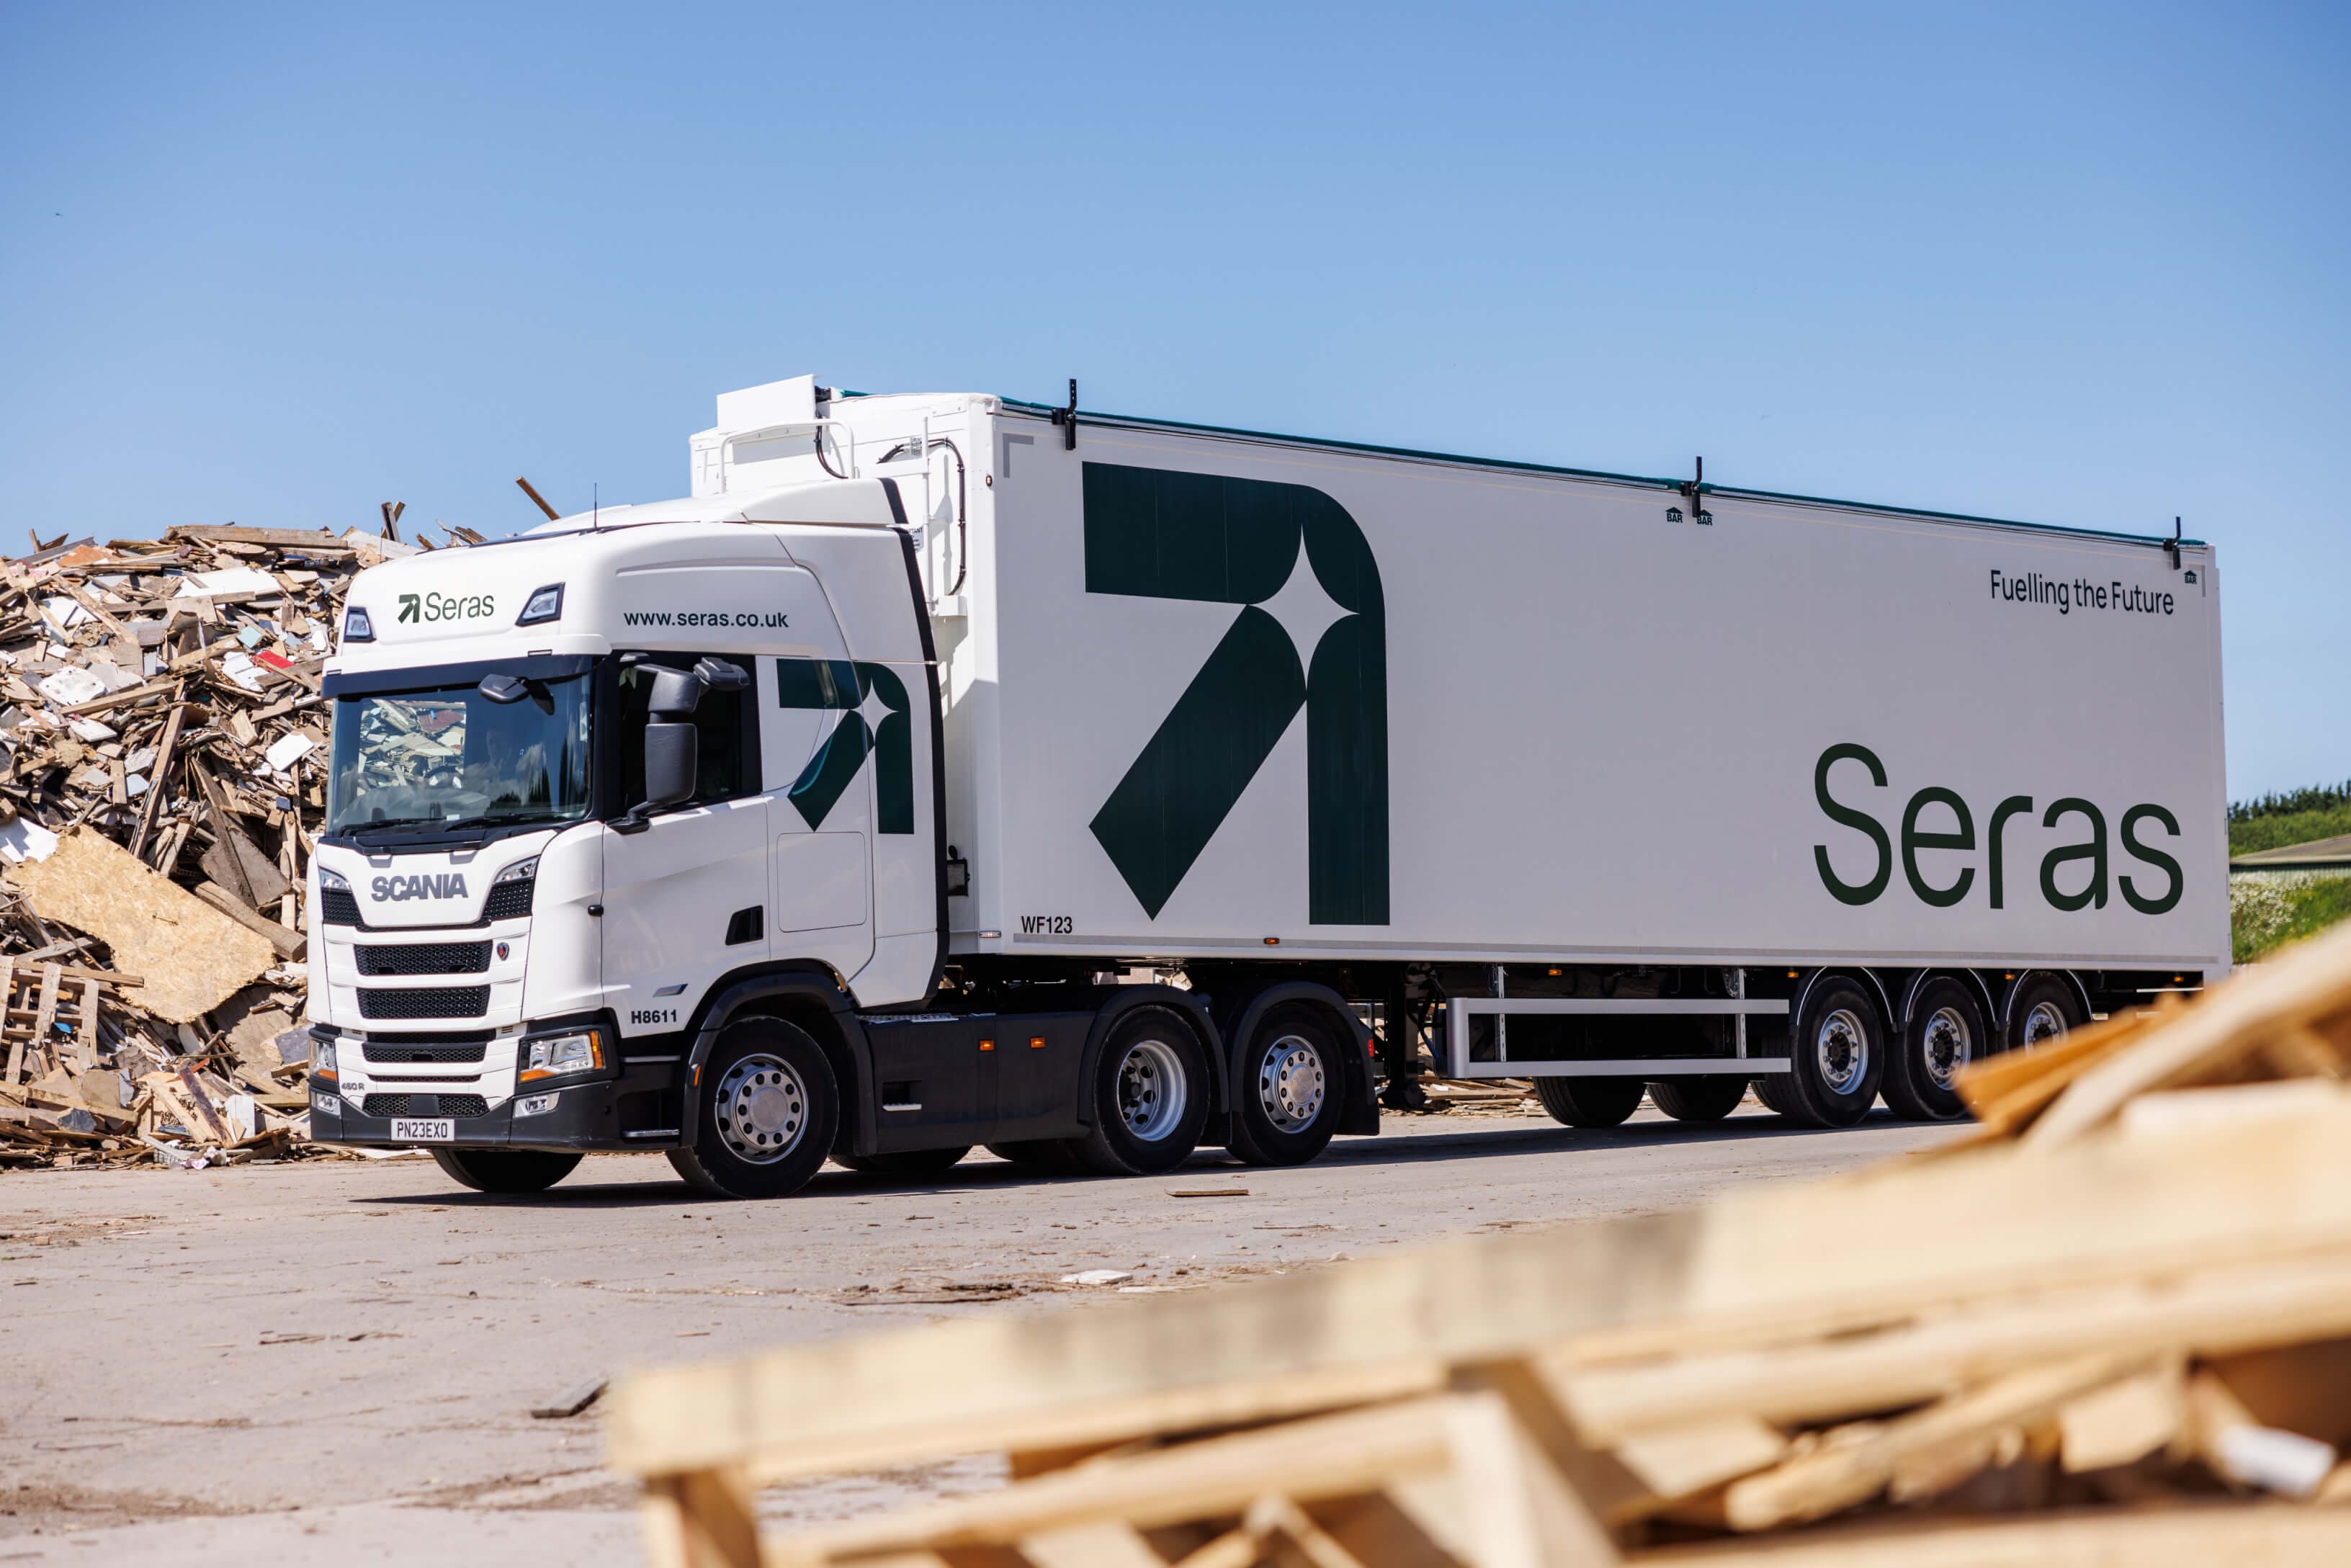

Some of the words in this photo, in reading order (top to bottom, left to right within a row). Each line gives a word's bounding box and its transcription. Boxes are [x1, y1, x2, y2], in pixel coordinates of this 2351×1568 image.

[1667, 513, 1683, 524] BAR
[1697, 516, 1713, 527] BAR
[1990, 569, 2069, 614] Fuelling
[2073, 578, 2108, 609] the
[2112, 581, 2174, 615] Future
[424, 591, 494, 622] Seras
[623, 612, 789, 628] www.seras.co.uk
[1813, 743, 2184, 915] Seras
[371, 873, 469, 902] SCANIA
[1021, 915, 1072, 934] WF123
[631, 1009, 677, 1024] H8611
